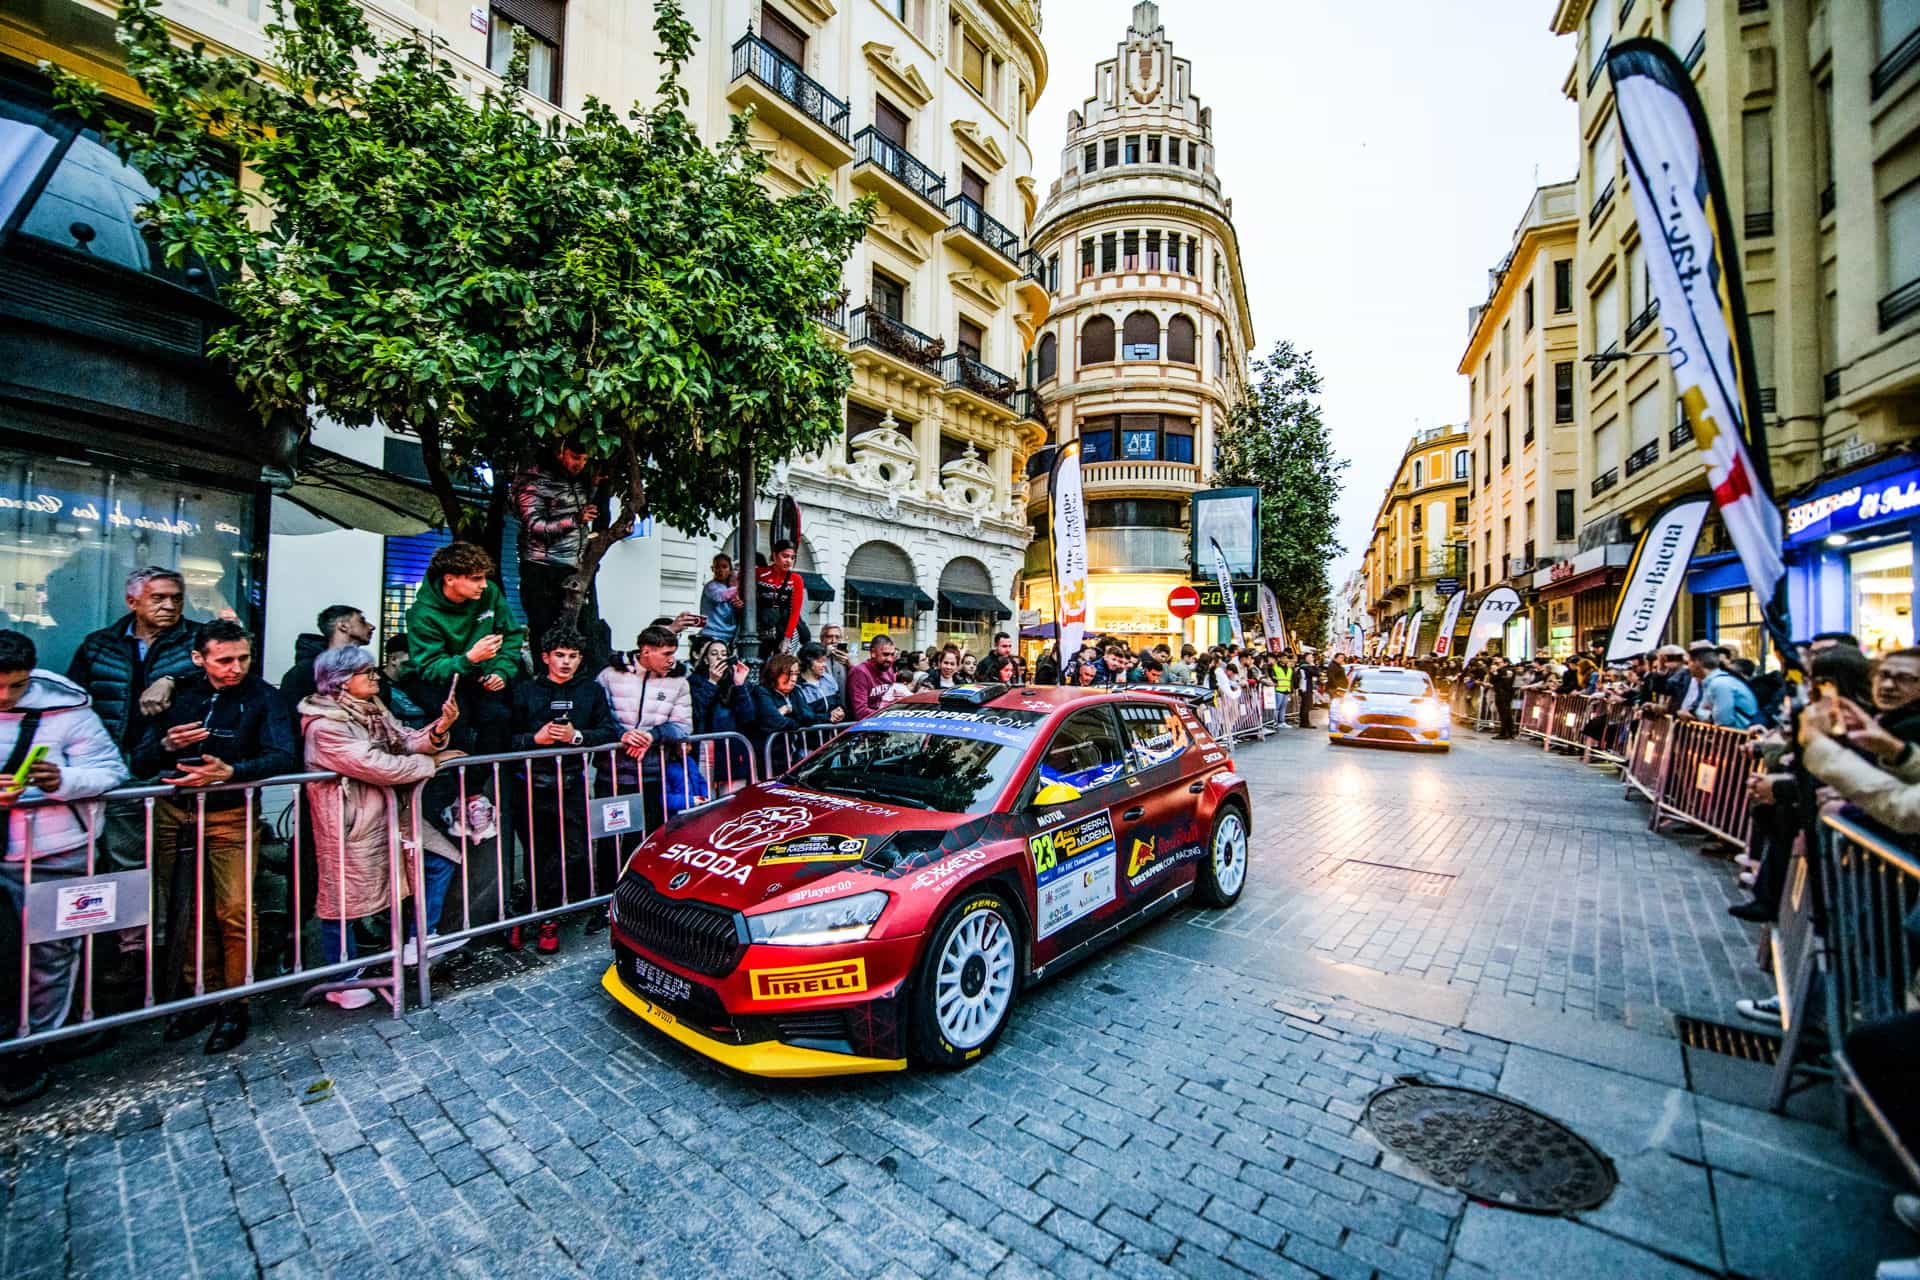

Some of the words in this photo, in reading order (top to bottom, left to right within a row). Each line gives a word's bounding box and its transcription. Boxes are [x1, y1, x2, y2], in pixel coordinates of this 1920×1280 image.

[1626, 596, 1658, 643] Peña
[1646, 523, 1684, 585] Baena
[1485, 600, 1517, 612] TXT
[1036, 810, 1067, 827] MOTUL
[1081, 816, 1109, 833] SIERRA
[842, 841, 858, 850] 23
[1077, 827, 1111, 847] MORENA
[1031, 832, 1056, 874] 23
[800, 885, 835, 901] Player
[758, 963, 860, 997] PIRELLI
